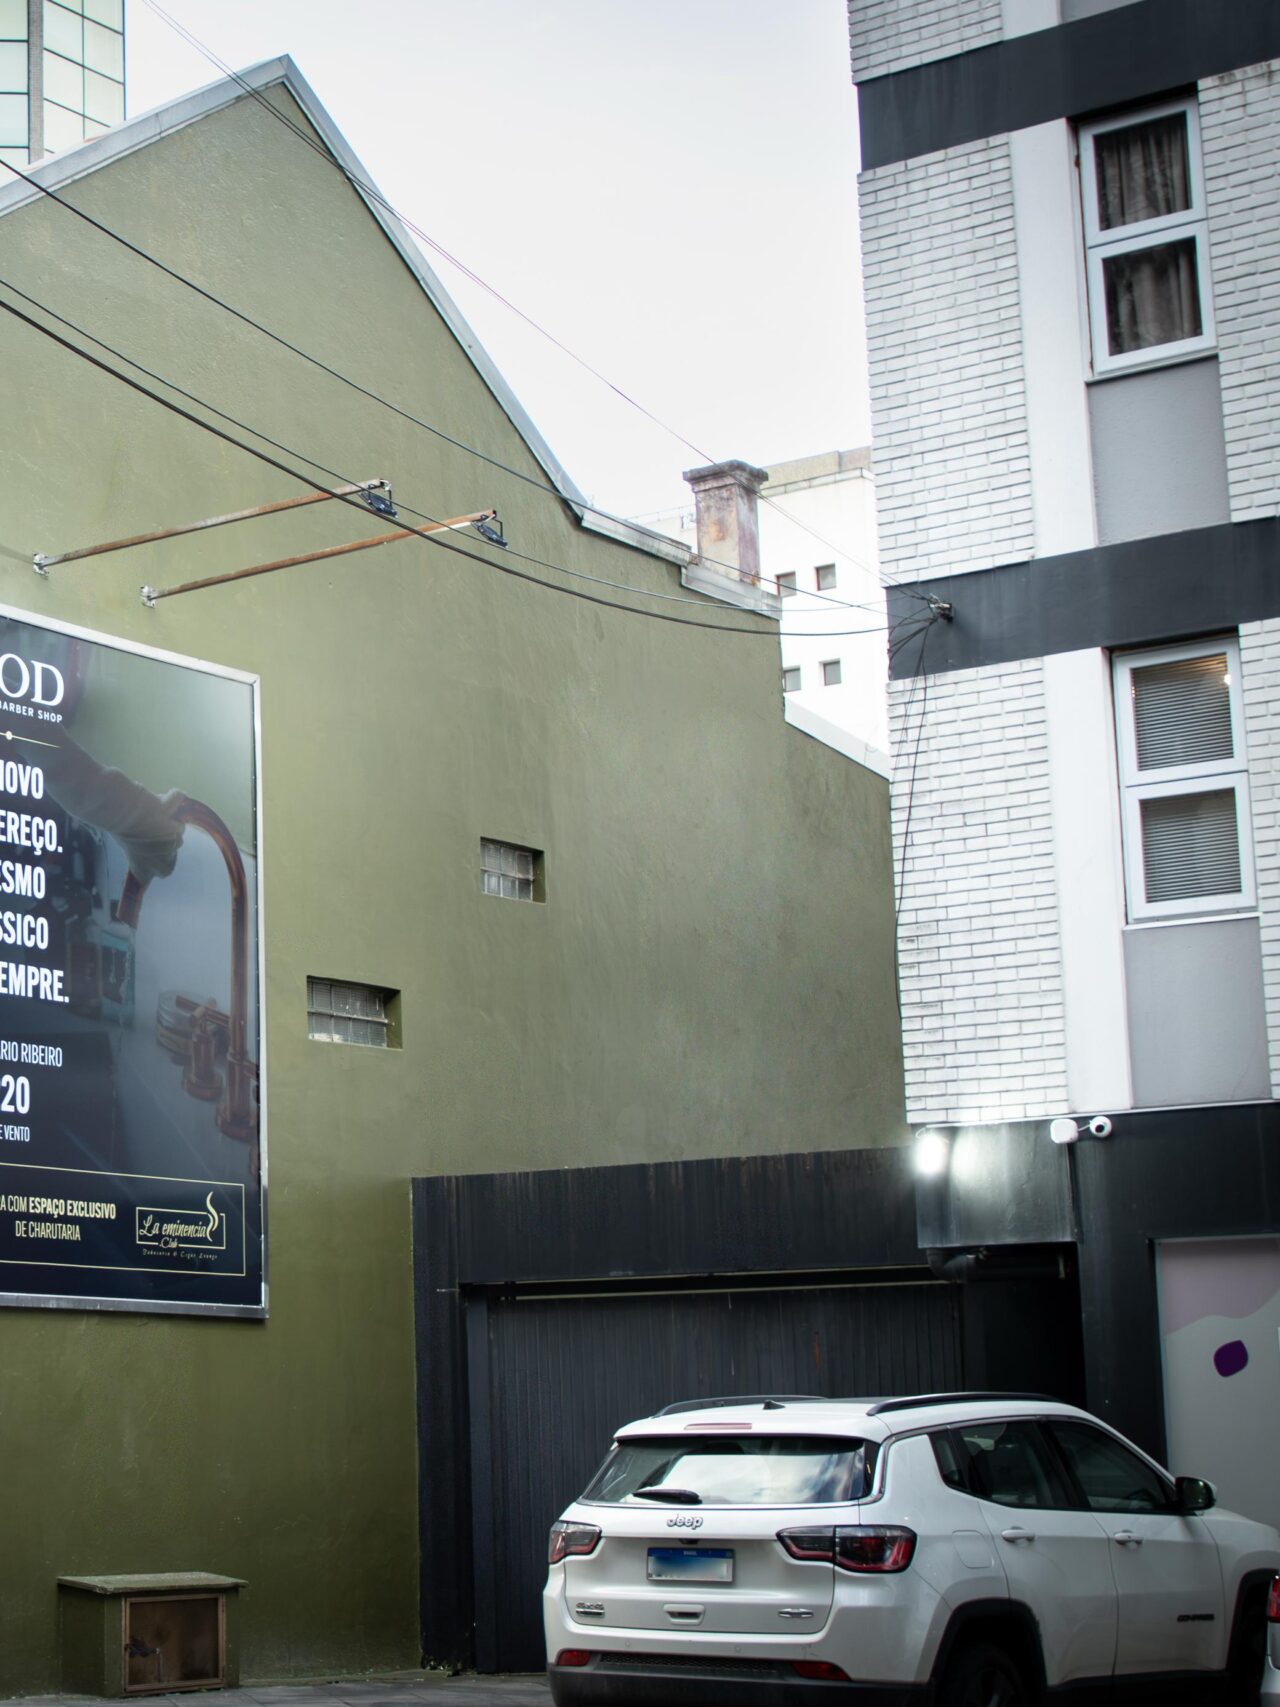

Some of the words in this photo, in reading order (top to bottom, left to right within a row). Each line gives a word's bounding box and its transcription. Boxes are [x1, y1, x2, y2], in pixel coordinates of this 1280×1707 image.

[38, 710, 62, 723] SHOP
[21, 1043, 63, 1067] RIBEIRO
[4, 1125, 30, 1142] VENTO
[8, 1195, 27, 1213] COM
[29, 1197, 65, 1218] ESPAÇO
[67, 1200, 116, 1220] EXCLUSIVO
[16, 1220, 27, 1237] DE
[29, 1221, 81, 1241] CHARUTARIA
[139, 1214, 159, 1236] La
[666, 1514, 704, 1529] Jeep
